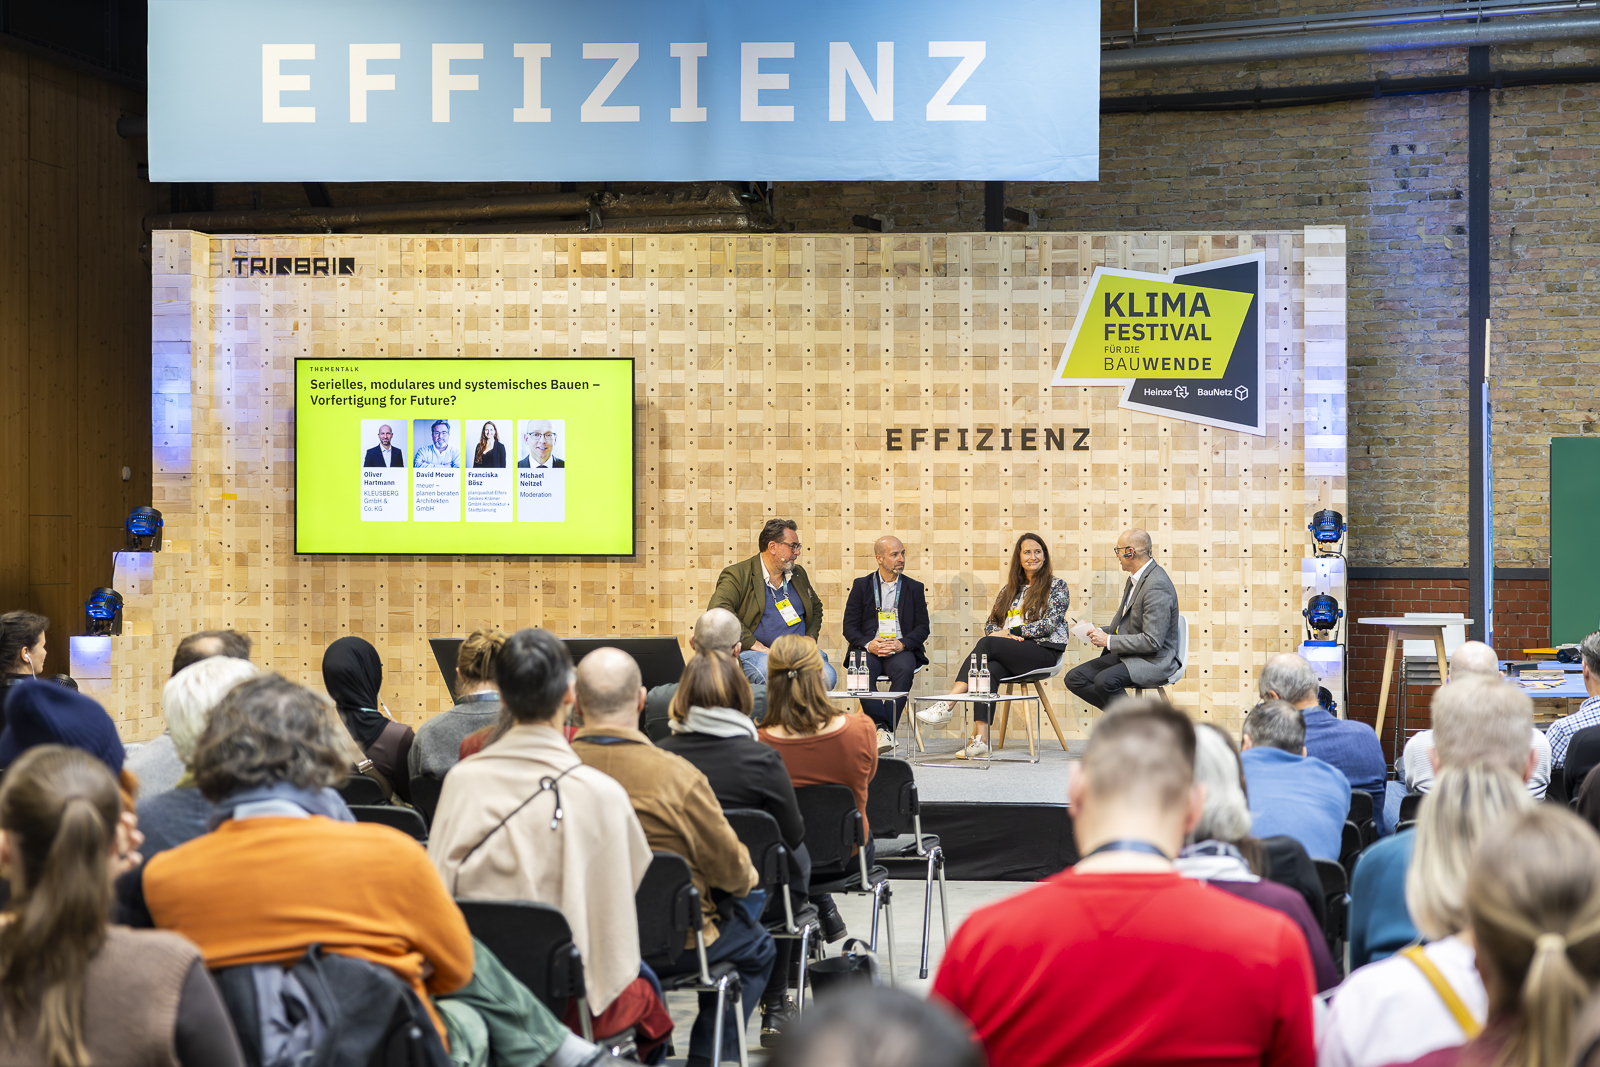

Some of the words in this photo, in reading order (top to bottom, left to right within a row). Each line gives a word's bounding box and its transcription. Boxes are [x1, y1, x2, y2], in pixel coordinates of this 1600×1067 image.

[262, 41, 988, 123] EFFIZIENZ
[232, 257, 355, 275] TRIQBRIQ
[1104, 292, 1211, 317] KLIMA
[1104, 324, 1211, 340] FESTIVAL
[1105, 345, 1121, 353] FÜR
[1104, 358, 1211, 370] BAUWENDE
[310, 379, 367, 392] Serielles,
[370, 379, 435, 390] modulares
[439, 379, 461, 390] und
[465, 379, 547, 392] systemisches
[551, 379, 589, 390] Bauen
[311, 394, 386, 408] Vorfertigung
[390, 394, 406, 405] for
[410, 395, 456, 406] Future?
[886, 428, 1091, 451] EFFIZIENZ
